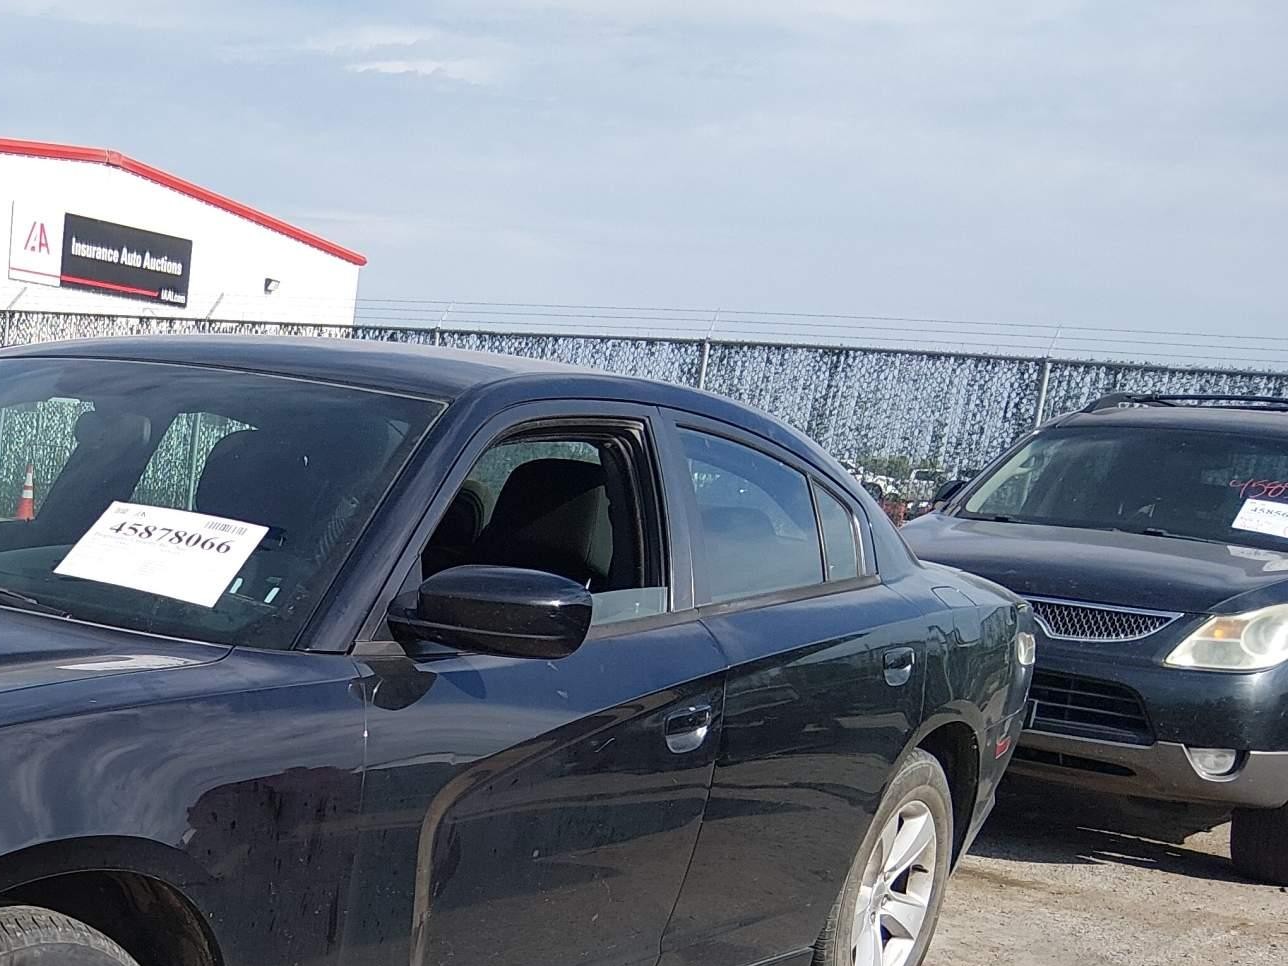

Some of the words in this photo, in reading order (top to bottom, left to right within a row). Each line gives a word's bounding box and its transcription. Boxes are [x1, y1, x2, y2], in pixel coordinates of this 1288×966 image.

[71, 237, 119, 264] Insurance
[120, 245, 142, 268] Auto
[144, 251, 183, 276] Auctions
[109, 520, 236, 555] 45878066
